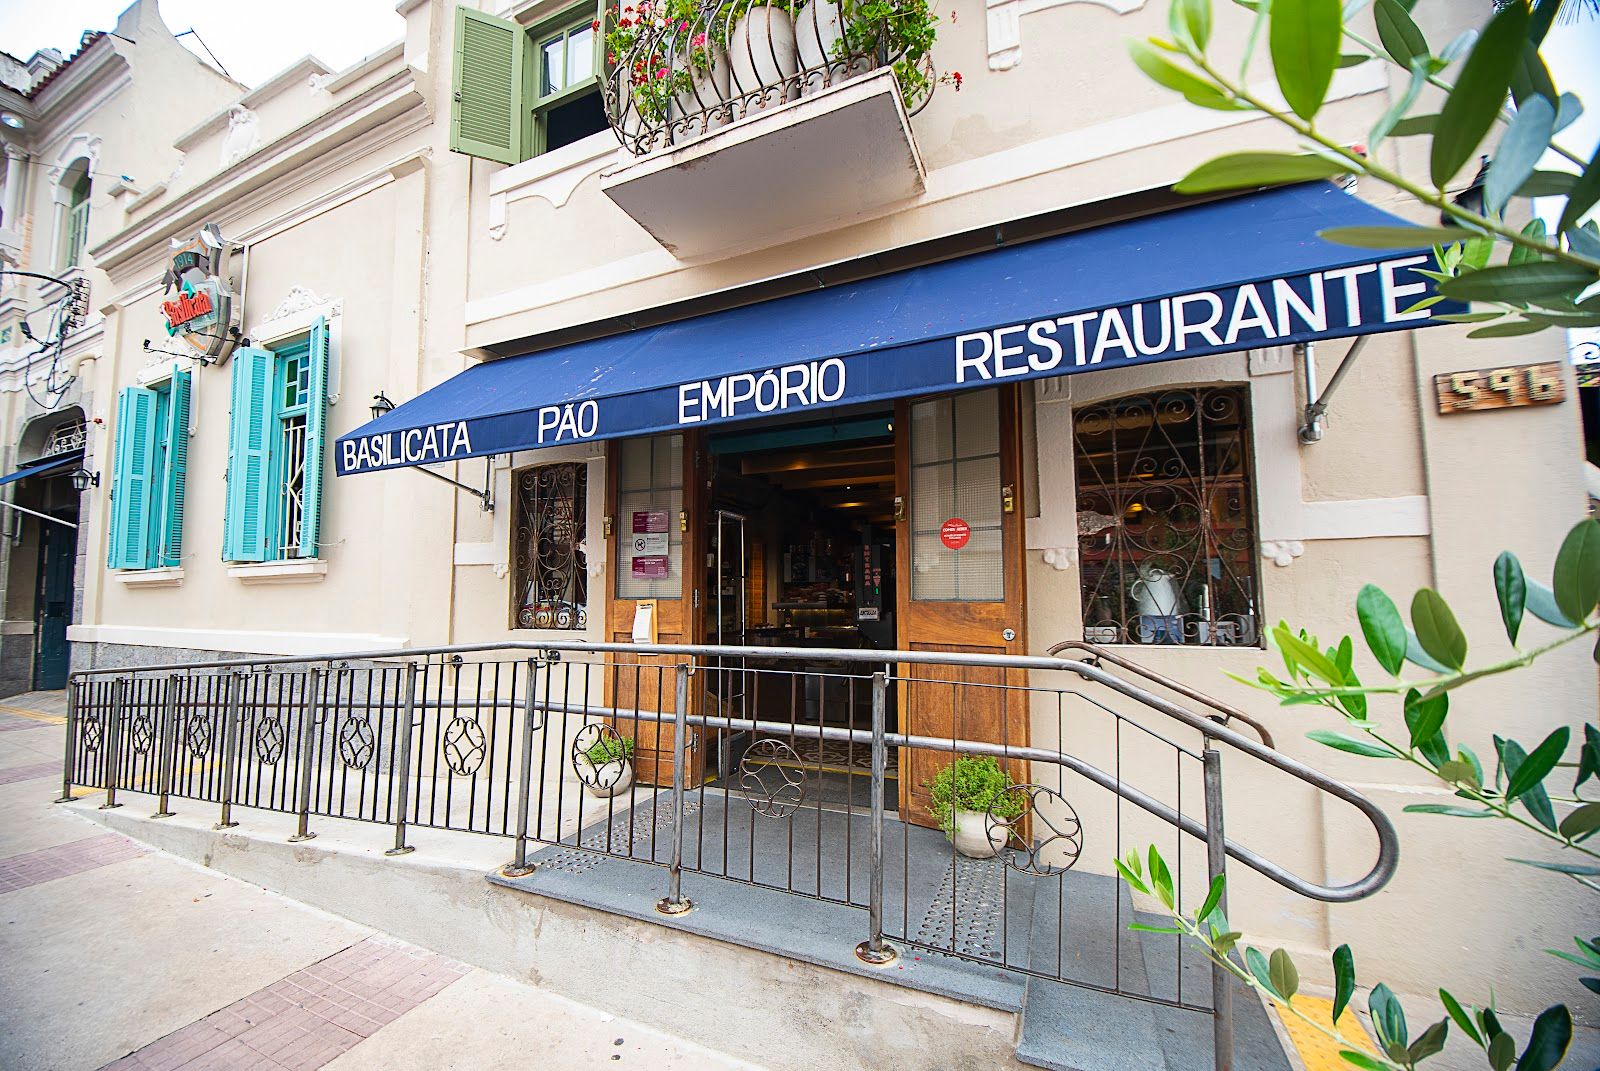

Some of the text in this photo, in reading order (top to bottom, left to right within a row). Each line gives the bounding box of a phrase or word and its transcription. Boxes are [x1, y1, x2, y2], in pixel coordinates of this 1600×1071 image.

[174, 254, 193, 269] 1914
[343, 255, 1432, 471] BASILICATA PÃO EMPÓRIO RESTAURANTE
[1451, 365, 1558, 409] 596
